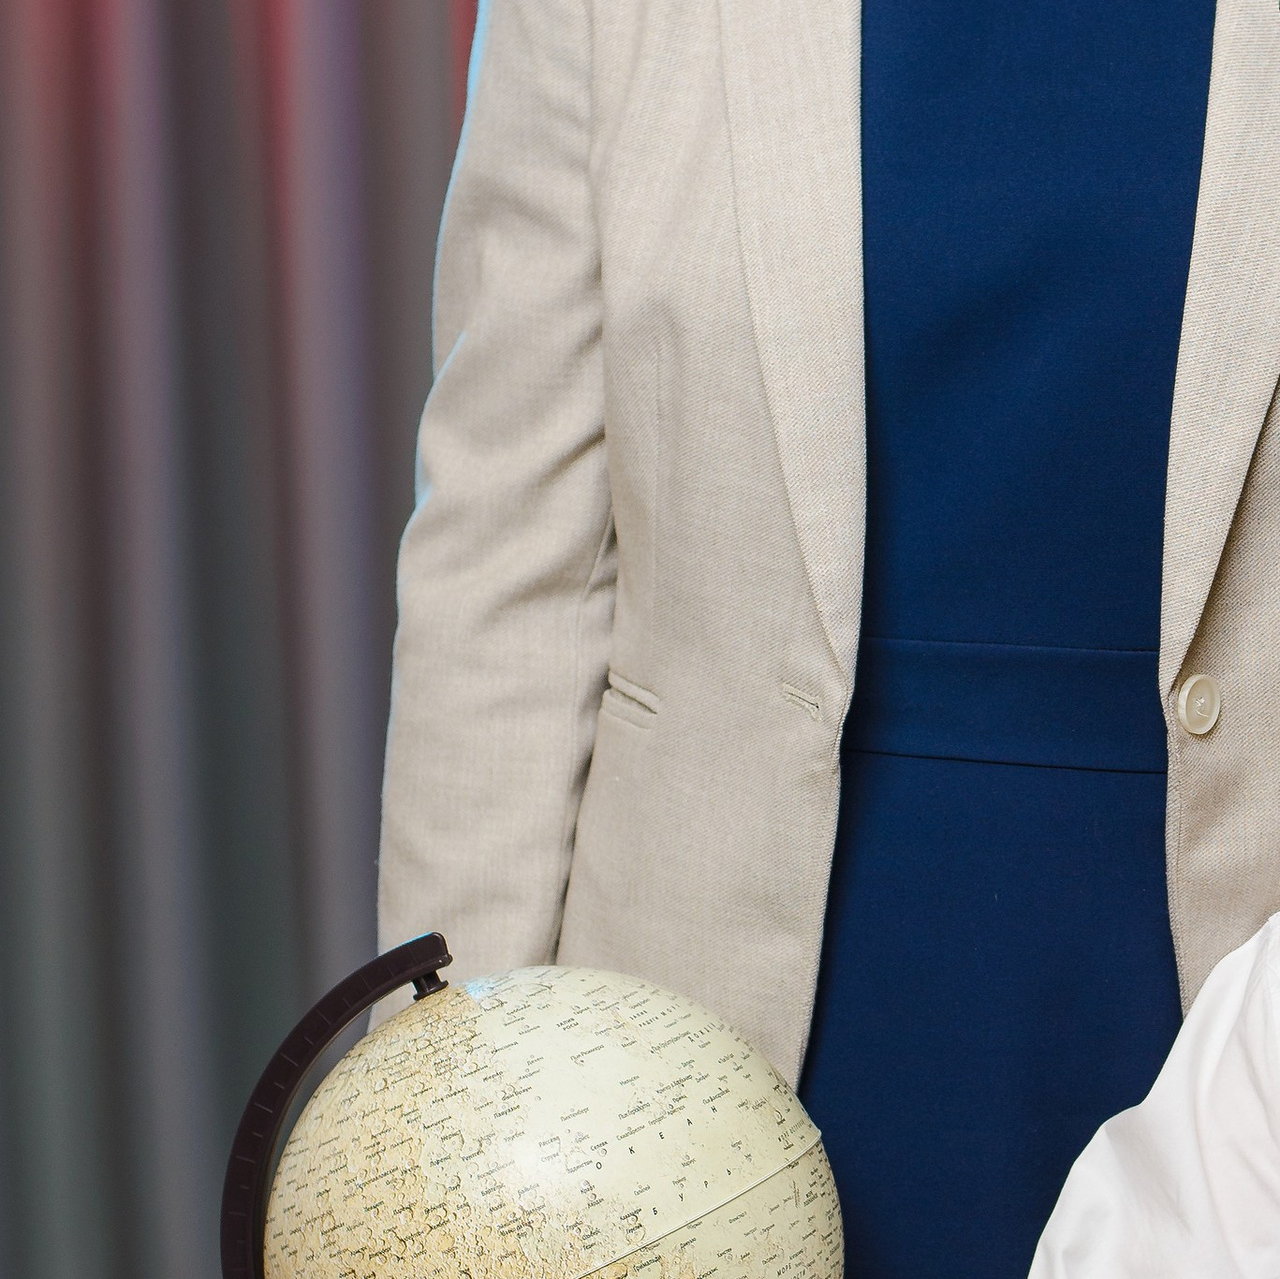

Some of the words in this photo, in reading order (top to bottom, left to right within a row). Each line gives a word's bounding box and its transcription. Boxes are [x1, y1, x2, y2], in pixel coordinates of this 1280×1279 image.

[556, 1017, 576, 1028] ЗАЛИВ
[562, 1021, 580, 1032] РОСЫ
[560, 1106, 590, 1123] Лихтенберг
[540, 1151, 560, 1164] Струве
[776, 1261, 793, 1278] МОРЕ
